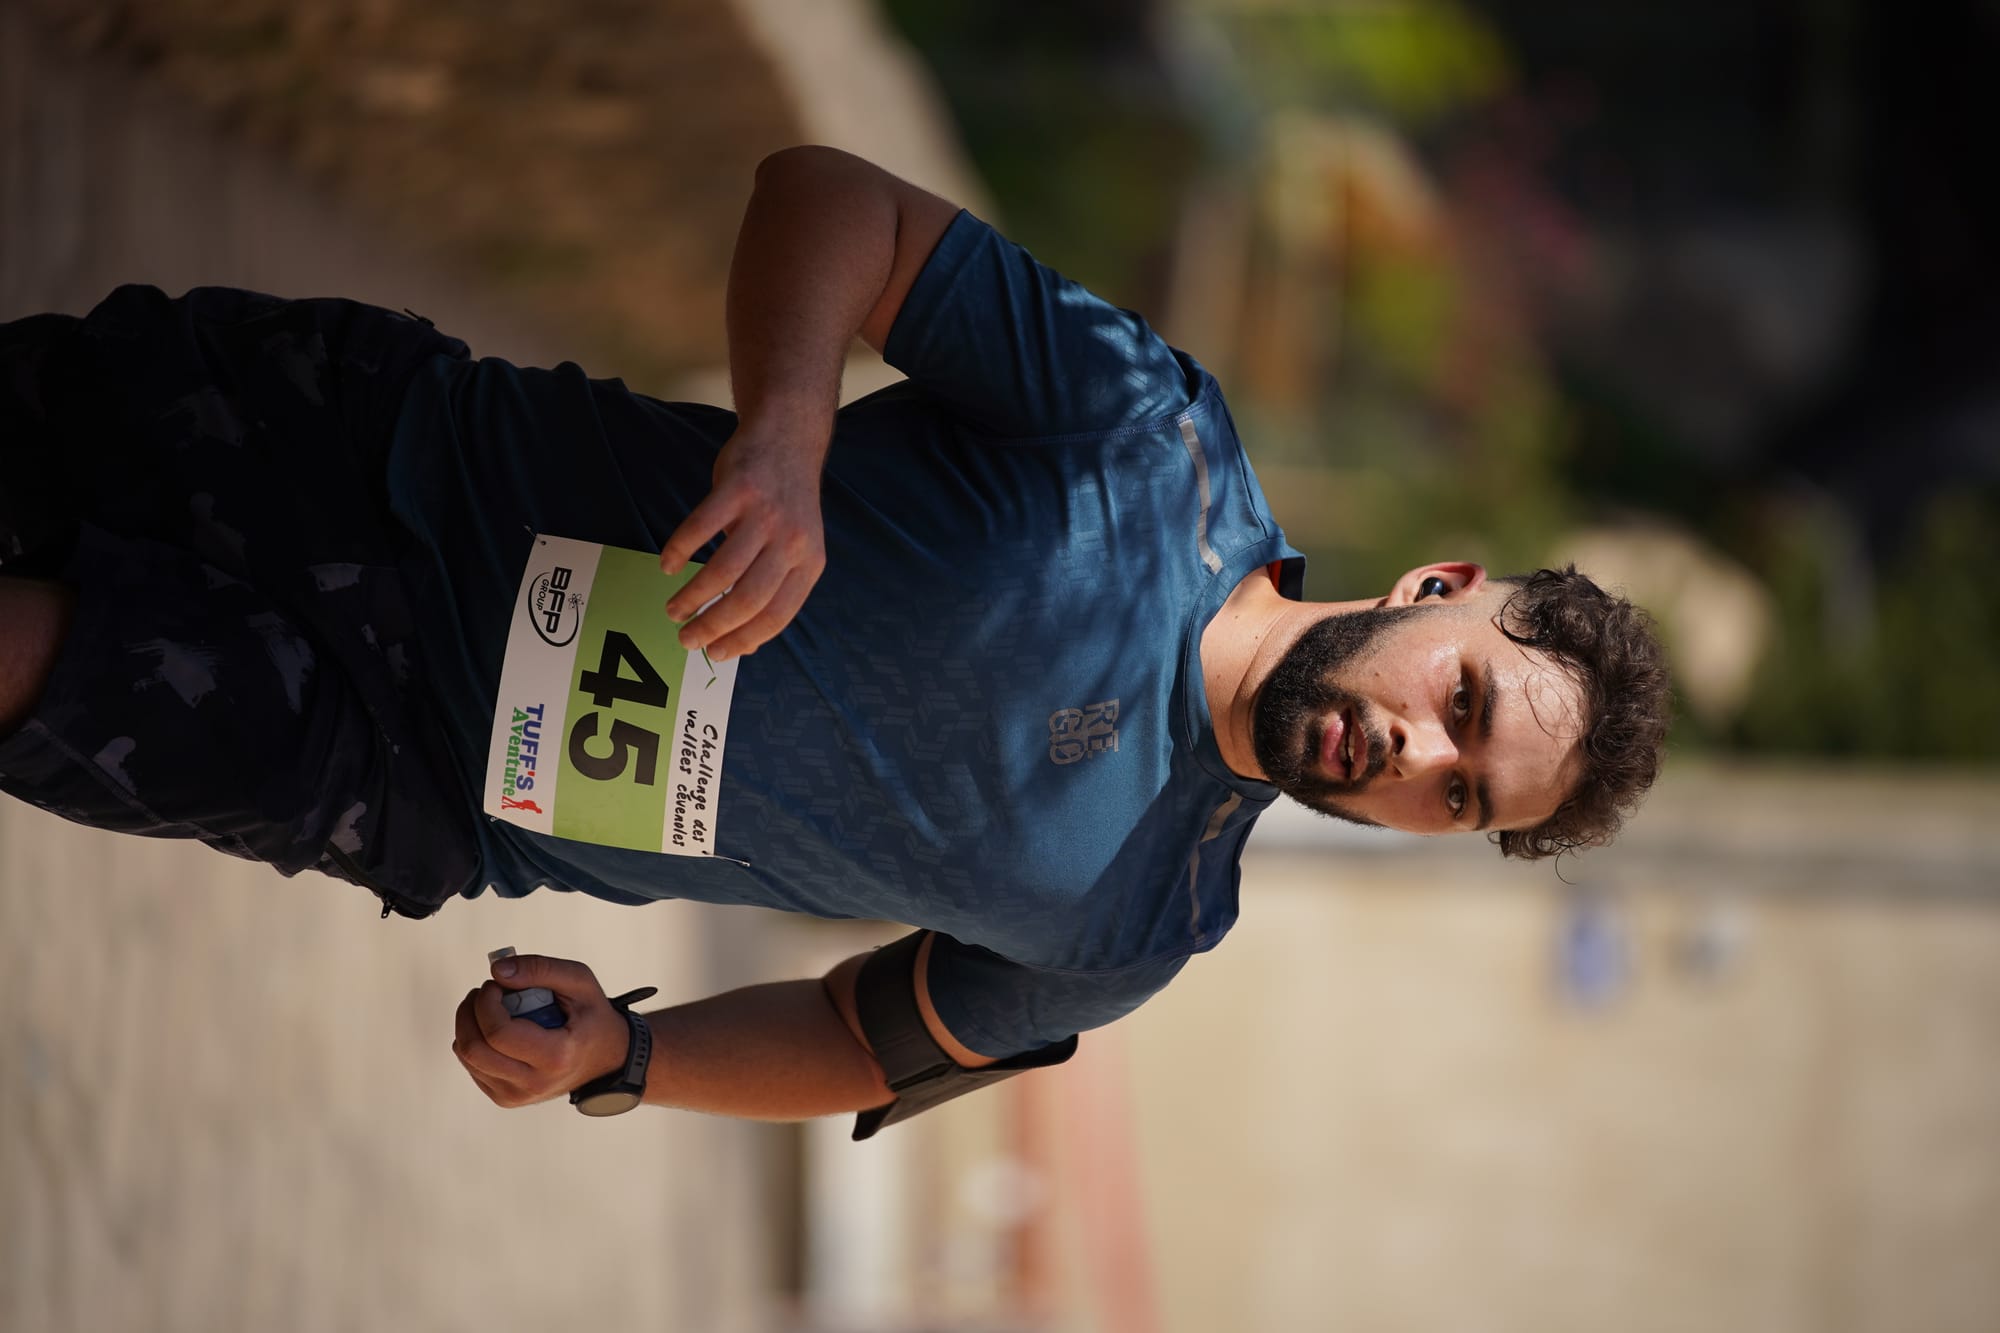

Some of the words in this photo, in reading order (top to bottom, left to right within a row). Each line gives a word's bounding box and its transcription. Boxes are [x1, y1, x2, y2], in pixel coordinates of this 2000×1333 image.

[536, 578, 550, 611] GROUP
[543, 566, 572, 634] BFP
[568, 629, 670, 787] 45
[501, 706, 530, 797] Aventure
[515, 703, 545, 791] TUFF'S
[679, 710, 698, 775] vallées
[690, 723, 718, 811] Challenge
[672, 783, 692, 847] cévenoles
[692, 817, 705, 843] des
